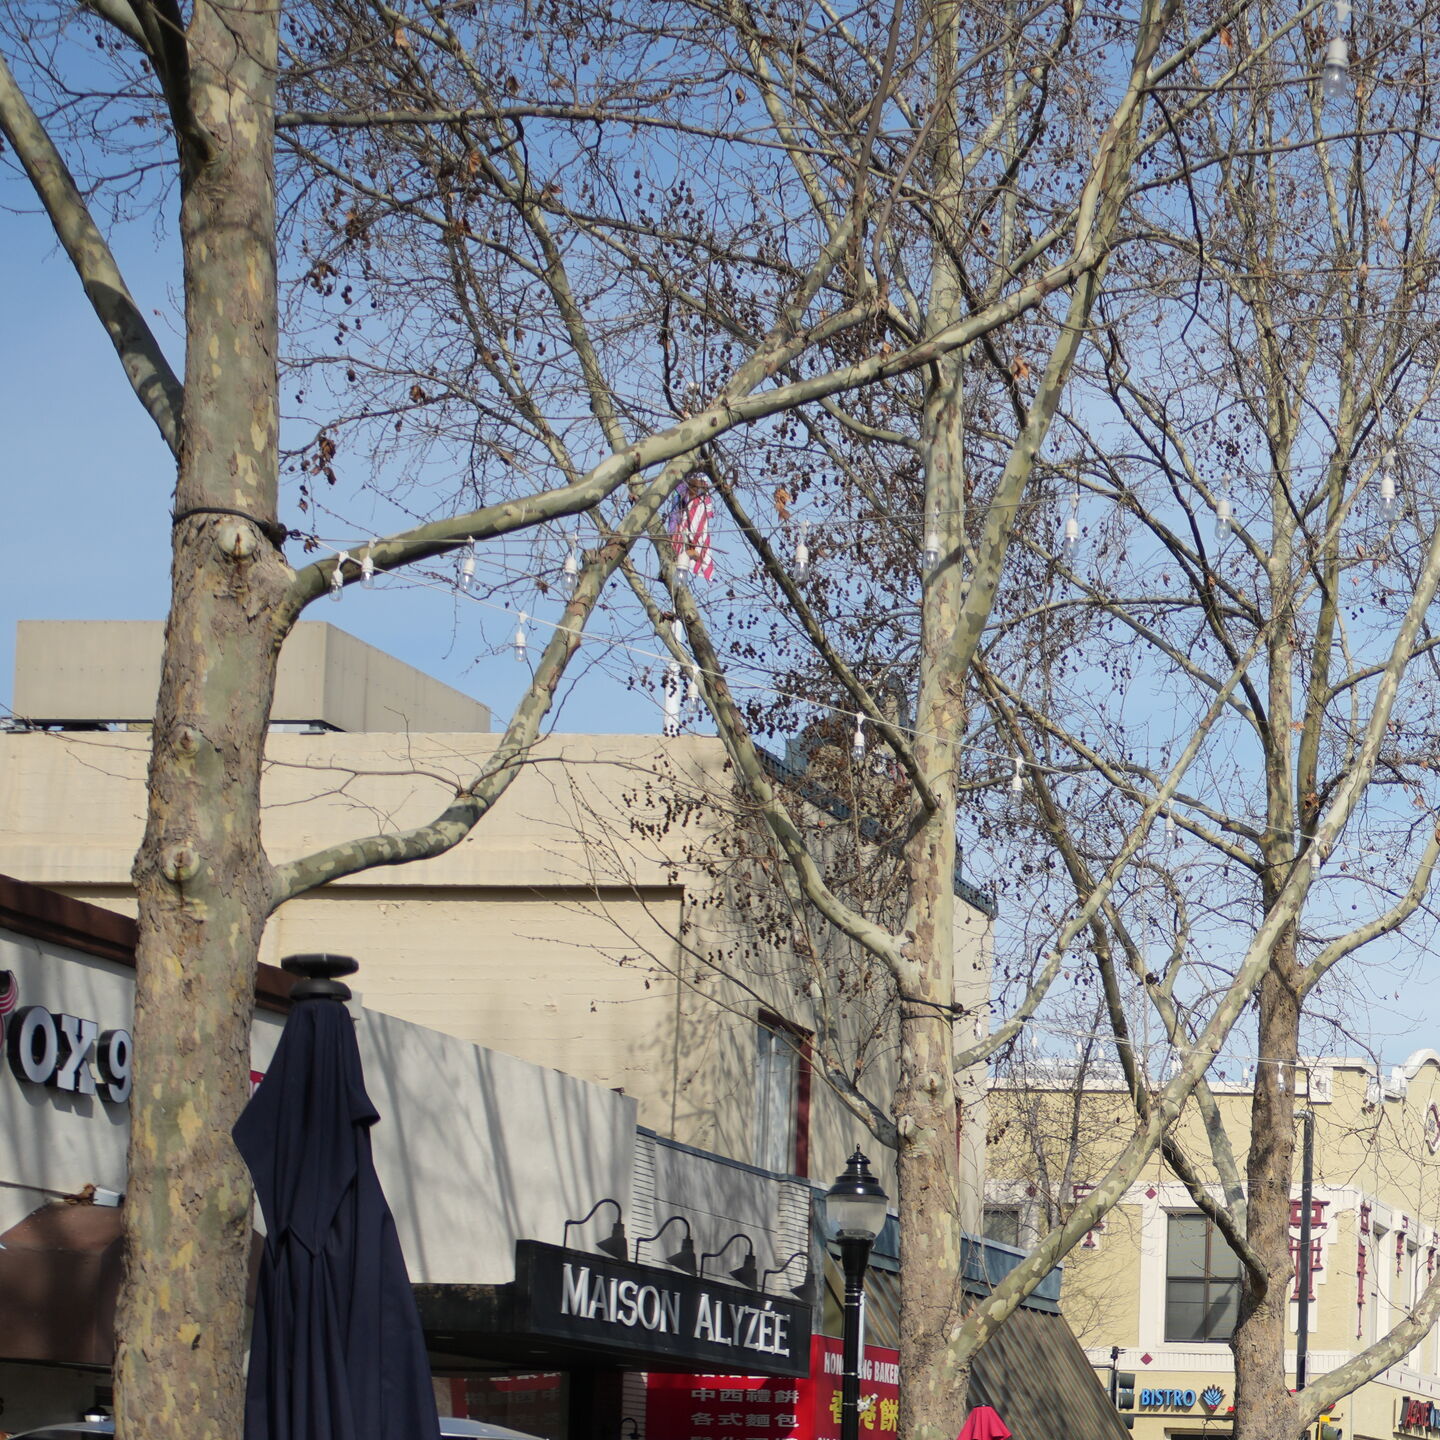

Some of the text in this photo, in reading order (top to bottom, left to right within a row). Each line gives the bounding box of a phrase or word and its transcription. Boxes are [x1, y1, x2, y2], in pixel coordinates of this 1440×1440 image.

[561, 1263, 790, 1357] MAISON ALYZÉE
[824, 1352, 843, 1375] HON
[874, 1361, 899, 1384] BAKER
[1140, 1388, 1197, 1407] BISTRO
